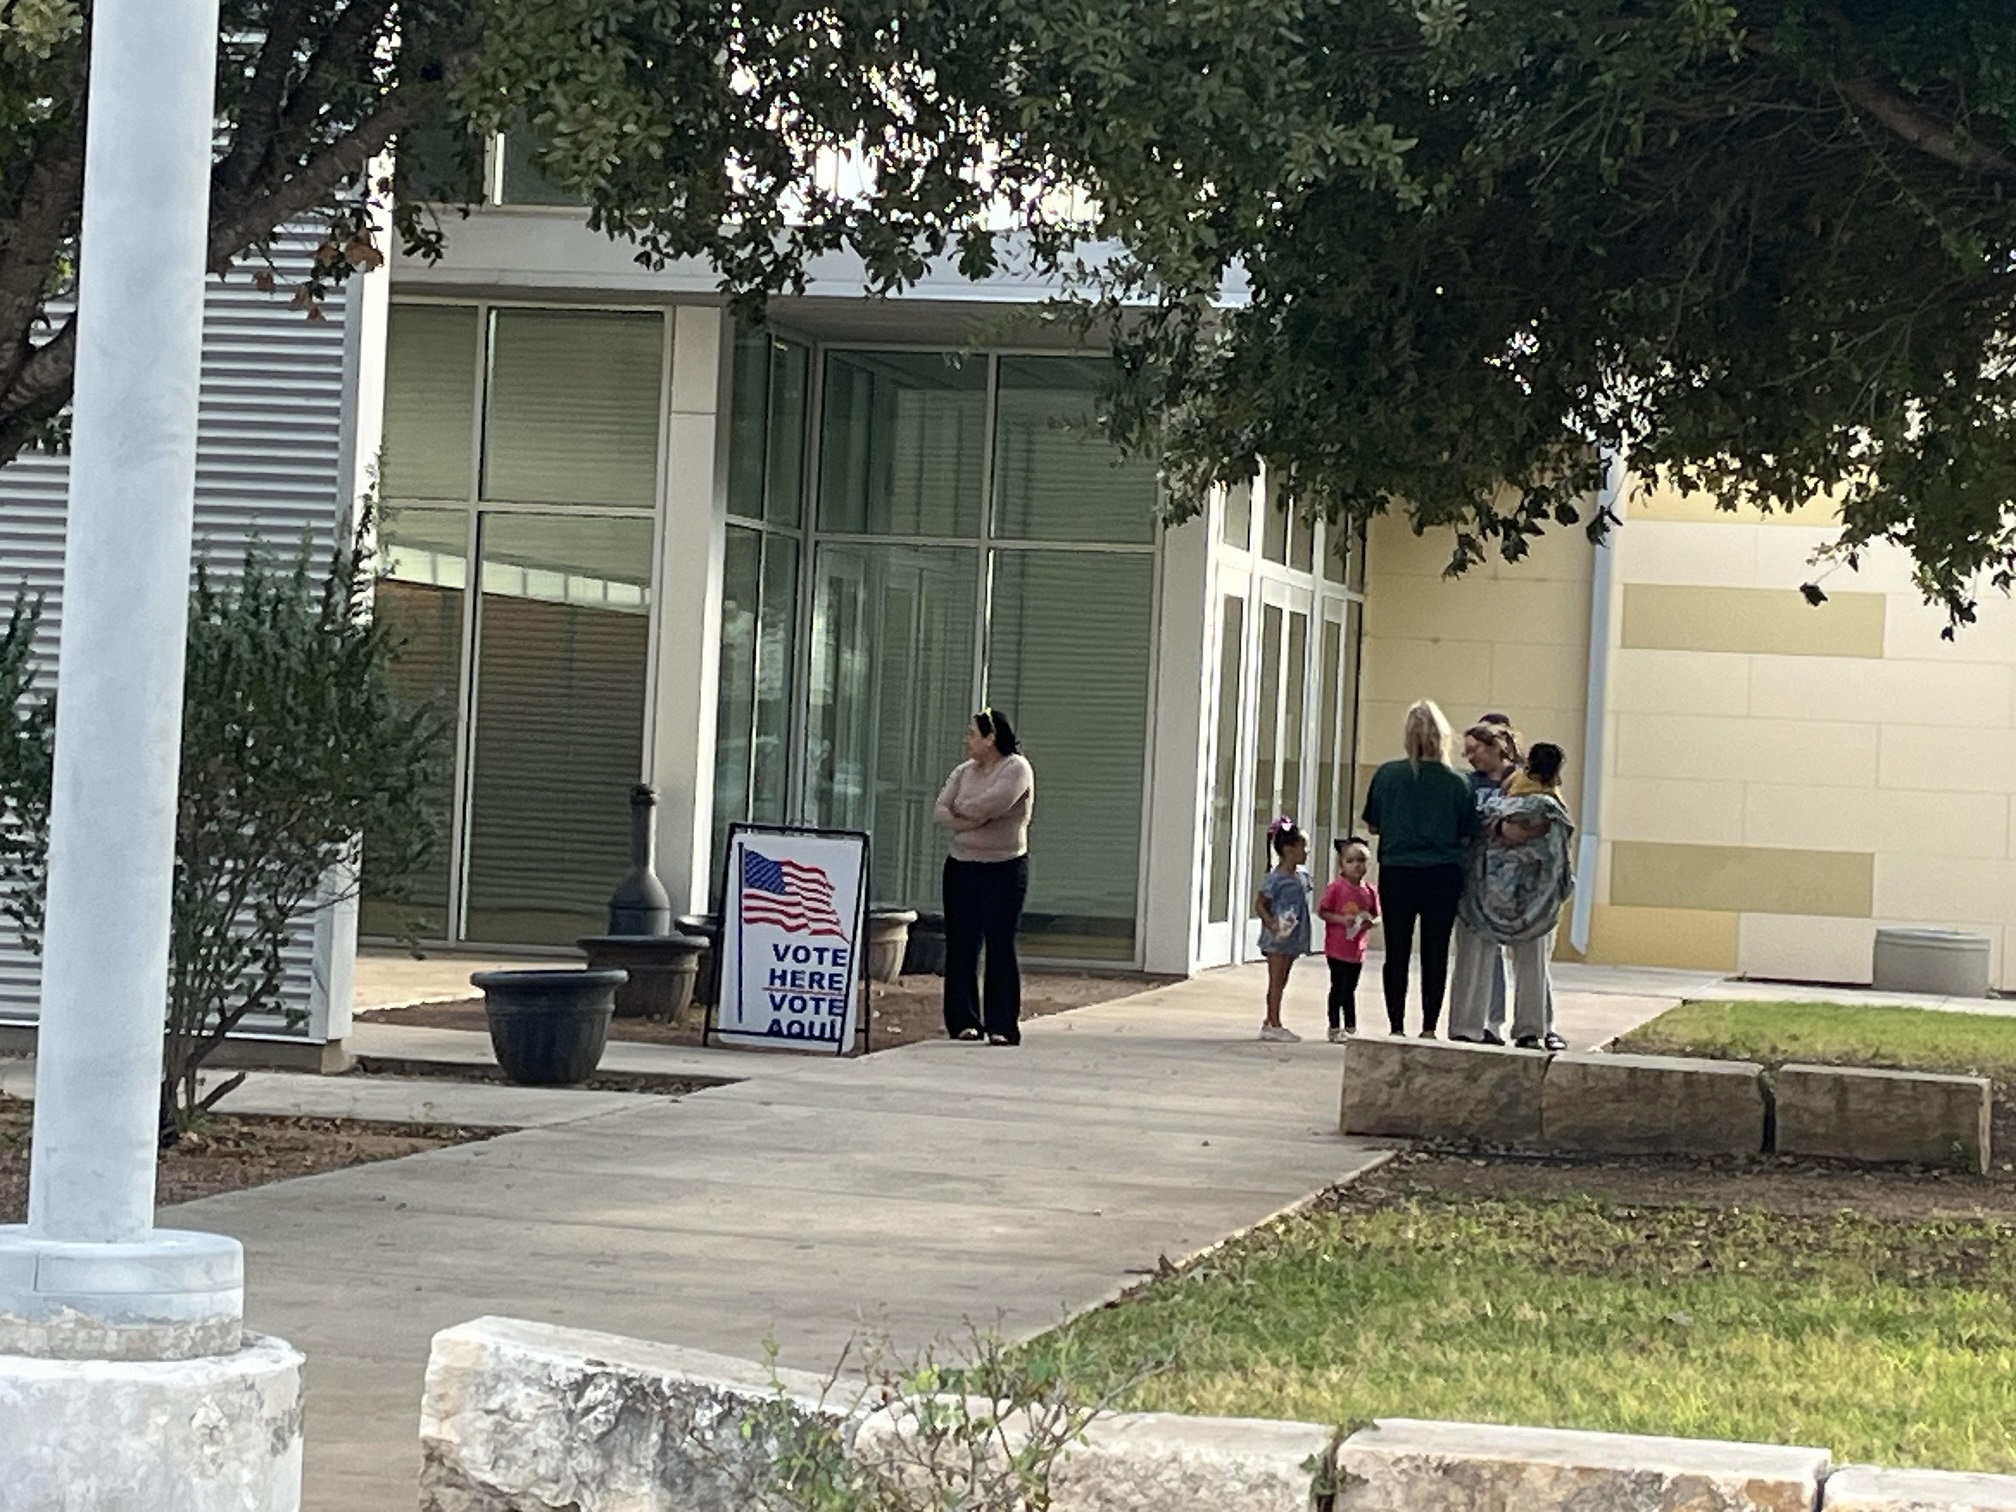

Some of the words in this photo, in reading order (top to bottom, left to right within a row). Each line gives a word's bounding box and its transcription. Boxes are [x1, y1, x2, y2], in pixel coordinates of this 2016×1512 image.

[773, 943, 848, 967] VOTE
[769, 968, 844, 990] HERE
[769, 994, 844, 1017] VOTE
